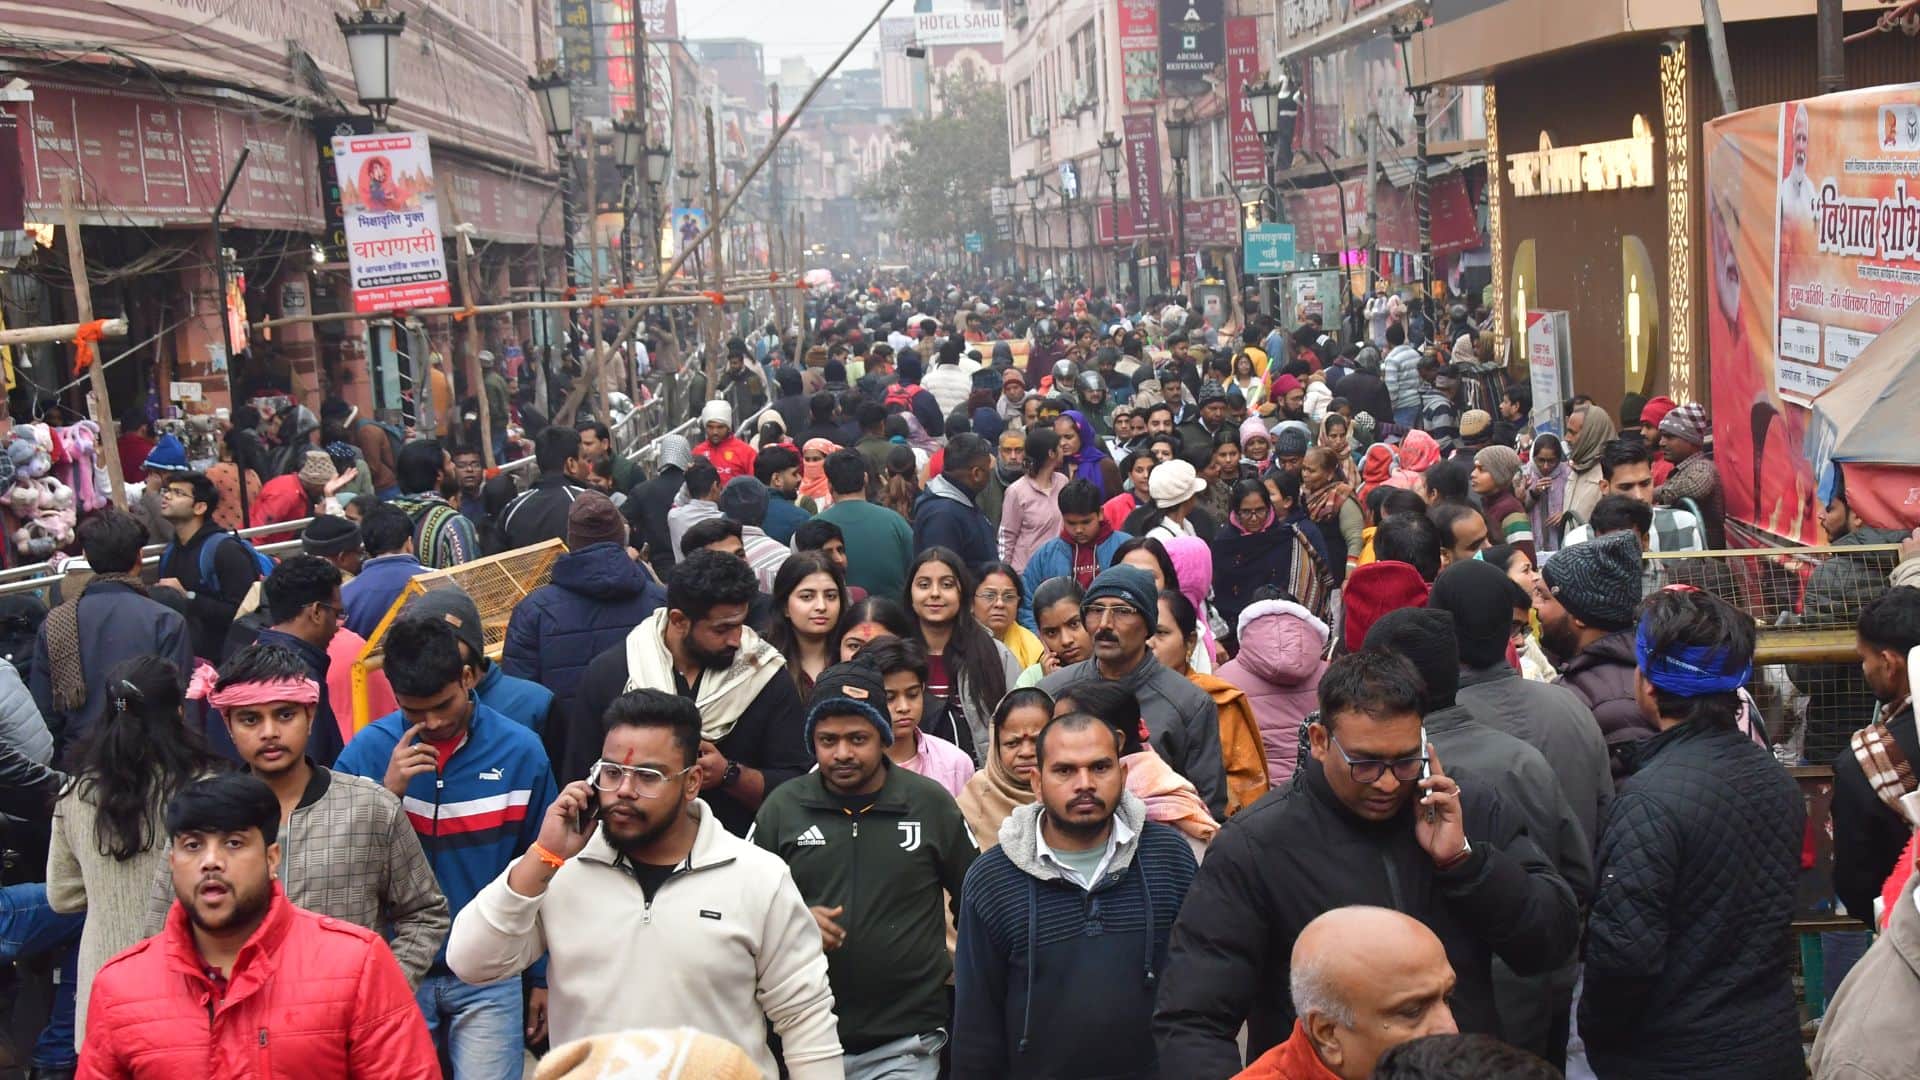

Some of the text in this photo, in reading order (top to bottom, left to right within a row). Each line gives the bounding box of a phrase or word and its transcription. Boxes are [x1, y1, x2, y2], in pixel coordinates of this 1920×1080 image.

[919, 12, 1000, 30] HOTEL SAHU
[1176, 53, 1204, 61] AROMA
[352, 228, 436, 258] वाराणसी
[1805, 284, 1824, 306] अतिथि
[797, 838, 826, 846] adidas
